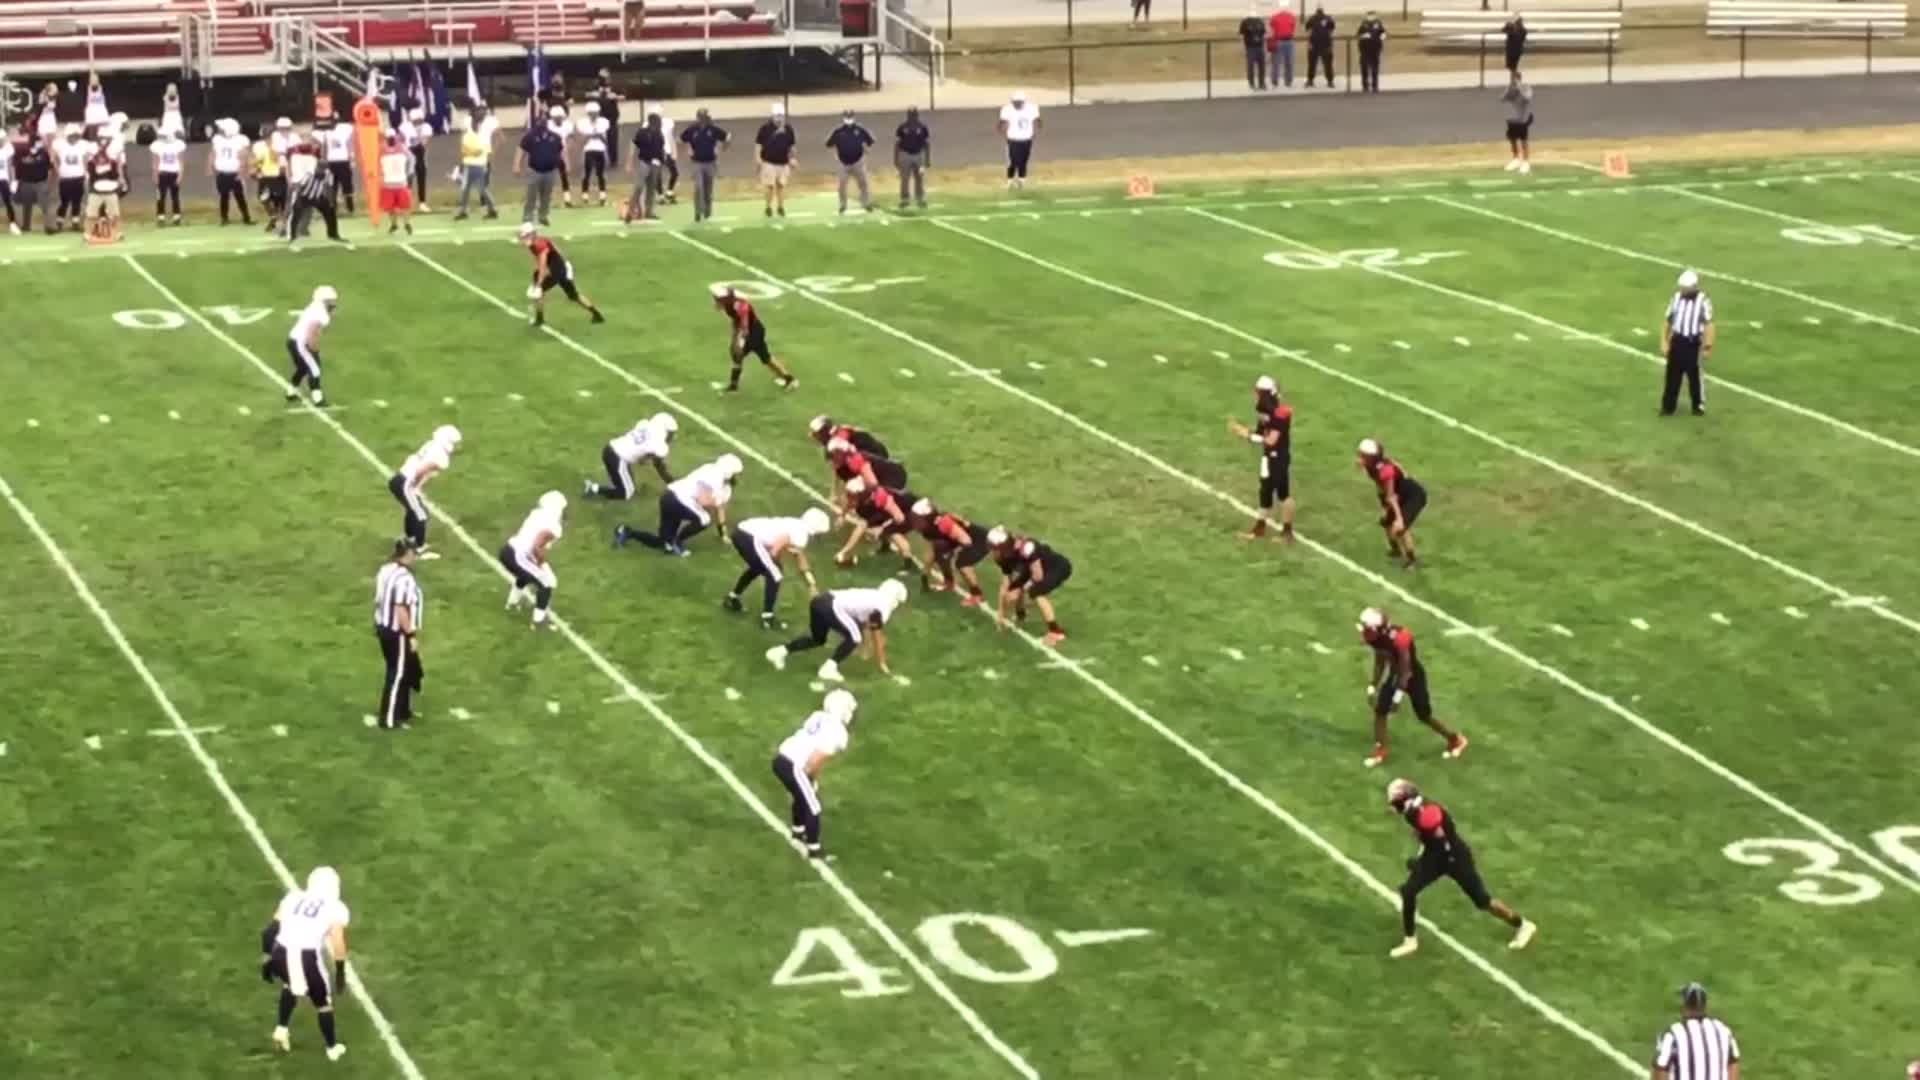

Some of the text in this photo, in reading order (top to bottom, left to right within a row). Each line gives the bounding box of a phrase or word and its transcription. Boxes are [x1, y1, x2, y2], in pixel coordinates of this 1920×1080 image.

[111, 304, 273, 329] 40
[293, 898, 325, 919] 18
[771, 911, 1059, 999] 40
